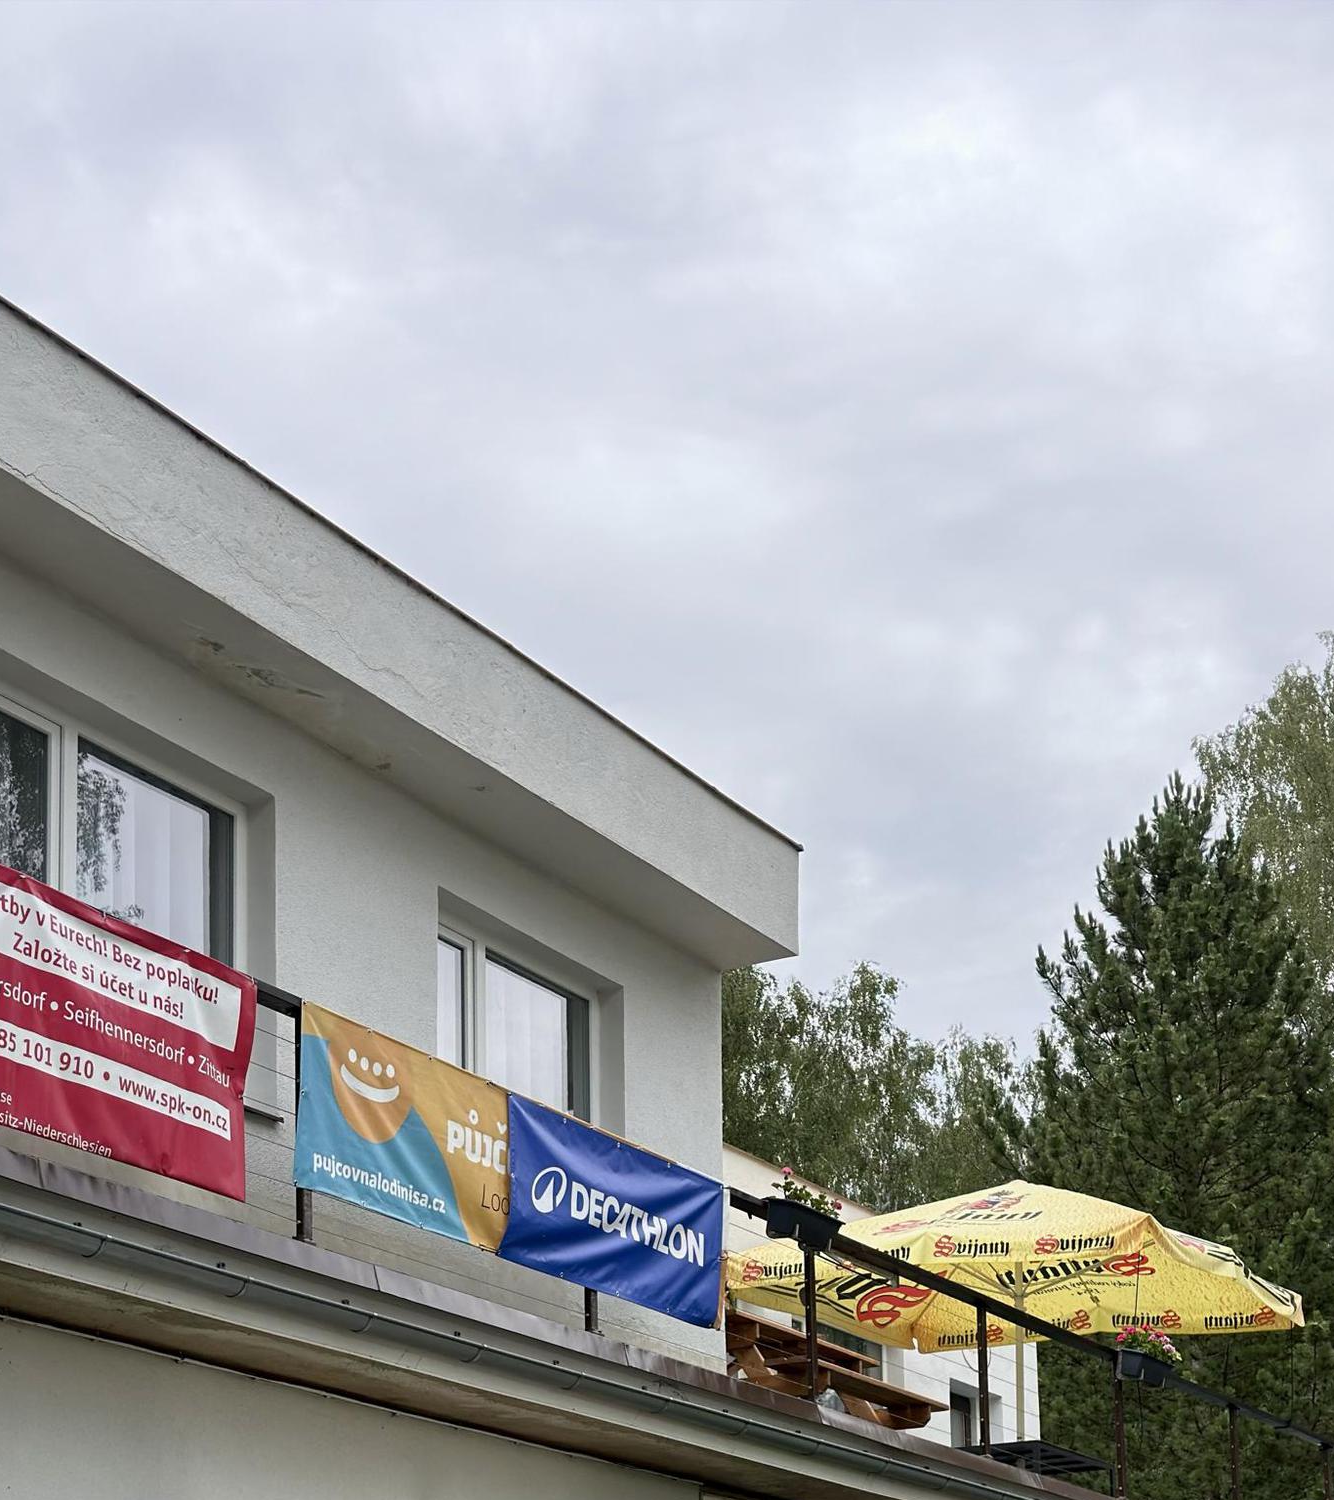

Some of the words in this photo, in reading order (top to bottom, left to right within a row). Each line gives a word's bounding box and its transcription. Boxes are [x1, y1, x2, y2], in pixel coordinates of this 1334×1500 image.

[12, 931, 78, 975] Založte
[81, 961, 96, 985] si
[98, 968, 135, 1002] účet
[138, 986, 149, 1007] u
[152, 991, 185, 1021] nás!
[35, 908, 47, 927] v
[49, 914, 109, 958] Eurech!
[112, 943, 142, 973] Bez
[145, 958, 220, 1005] poplatku!
[63, 1000, 185, 1066] Seifhennersdorf
[197, 1054, 231, 1089] Zittau
[23, 1036, 53, 1068] 101
[59, 1048, 95, 1081] 910
[118, 1074, 229, 1134] www.spk-on.cz
[446, 1108, 507, 1176] PŮJČ
[312, 1150, 447, 1216] pujcovnalodinisa.cz
[480, 1183, 510, 1216] Lod
[570, 1180, 706, 1269] DECATHLON
[933, 1235, 1010, 1259] Svijany
[1034, 1233, 1116, 1256] Svijany
[742, 1258, 805, 1283] Svijan
